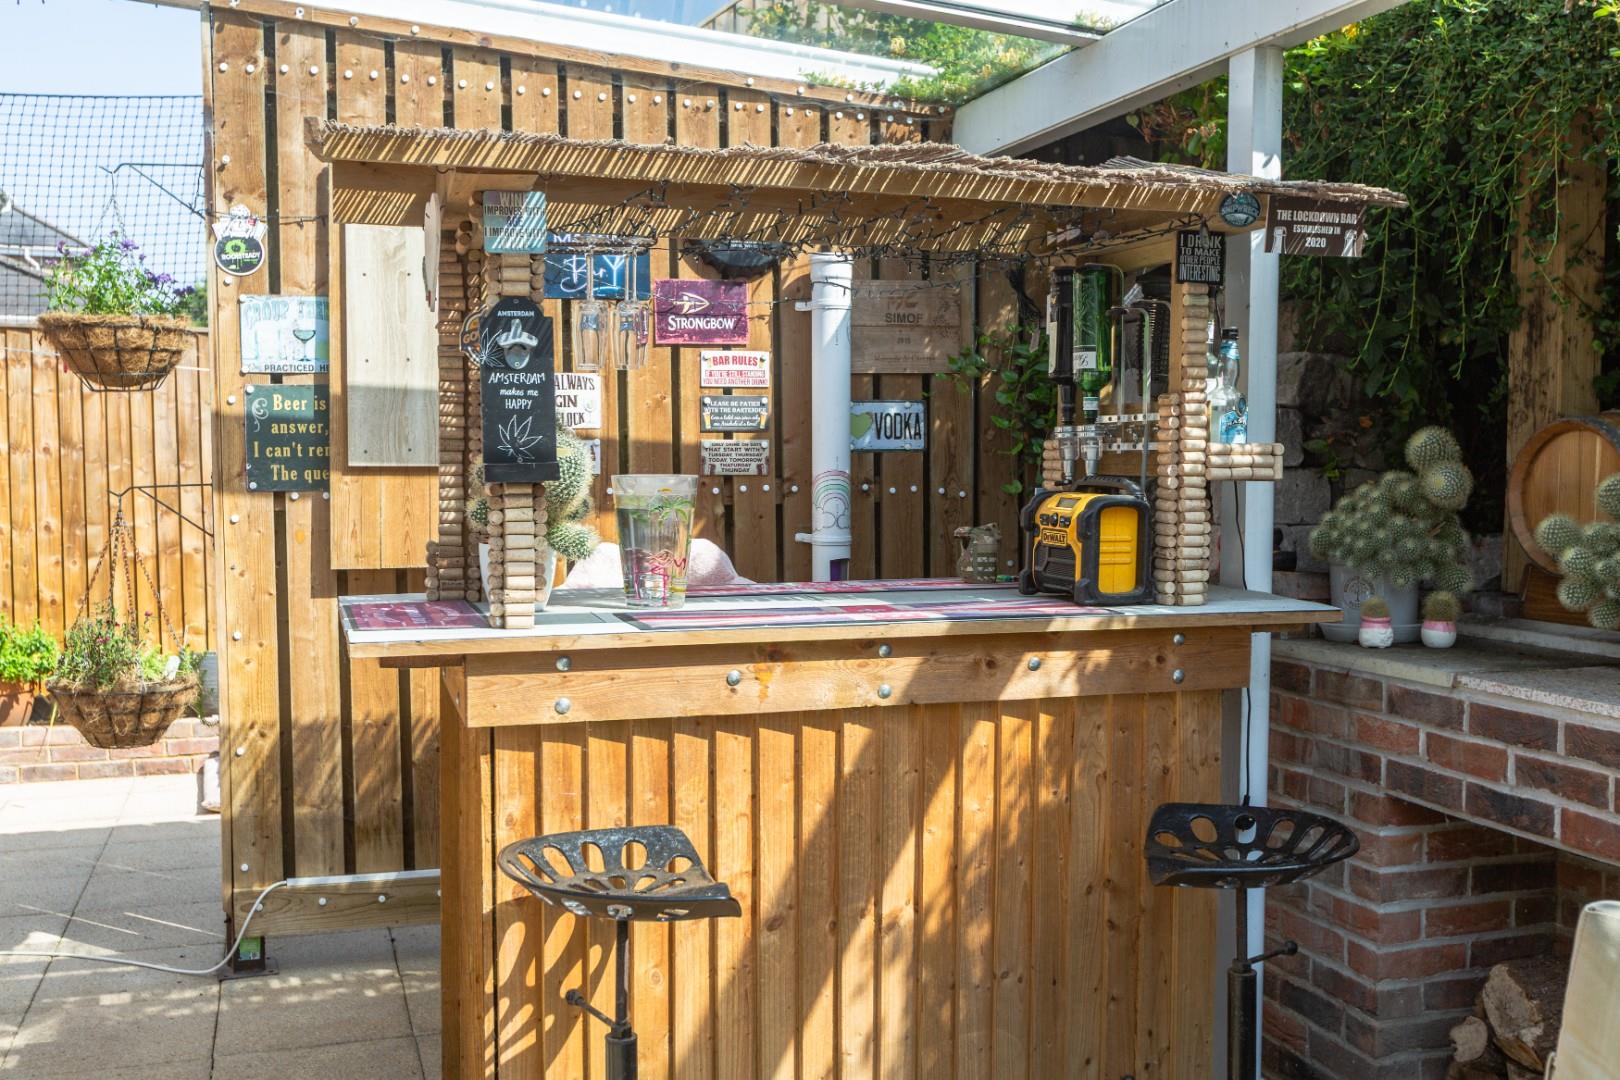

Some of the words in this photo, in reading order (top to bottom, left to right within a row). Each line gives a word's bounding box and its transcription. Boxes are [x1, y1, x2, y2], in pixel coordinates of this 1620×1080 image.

[1277, 209, 1292, 221] THE
[1293, 210, 1339, 223] LOCKDOWN
[1340, 213, 1357, 225] BAR
[1293, 224, 1333, 235] ESTABLISHED
[1334, 226, 1341, 235] IN
[1180, 233, 1184, 247] I
[1305, 237, 1327, 248] 2020
[1180, 247, 1192, 255] TO
[1194, 248, 1220, 257] MAKE
[1200, 256, 1220, 265] PEOPLE
[1179, 264, 1221, 282] INTERESTING
[667, 315, 736, 331] STRONGBOW
[264, 363, 315, 372] PRACTICED
[712, 355, 731, 367] BAR
[732, 355, 759, 367] RULES
[488, 372, 546, 384] AMSTERDAM
[500, 387, 525, 396] makes
[526, 388, 540, 396] me
[272, 393, 308, 411] Beer
[314, 394, 327, 411] is
[505, 398, 533, 410] HAPPY
[555, 394, 577, 408] GIN
[271, 422, 328, 435] answer,
[874, 411, 922, 440] VODKA
[254, 441, 259, 457] I
[265, 441, 303, 458] can't
[270, 464, 298, 481] The
